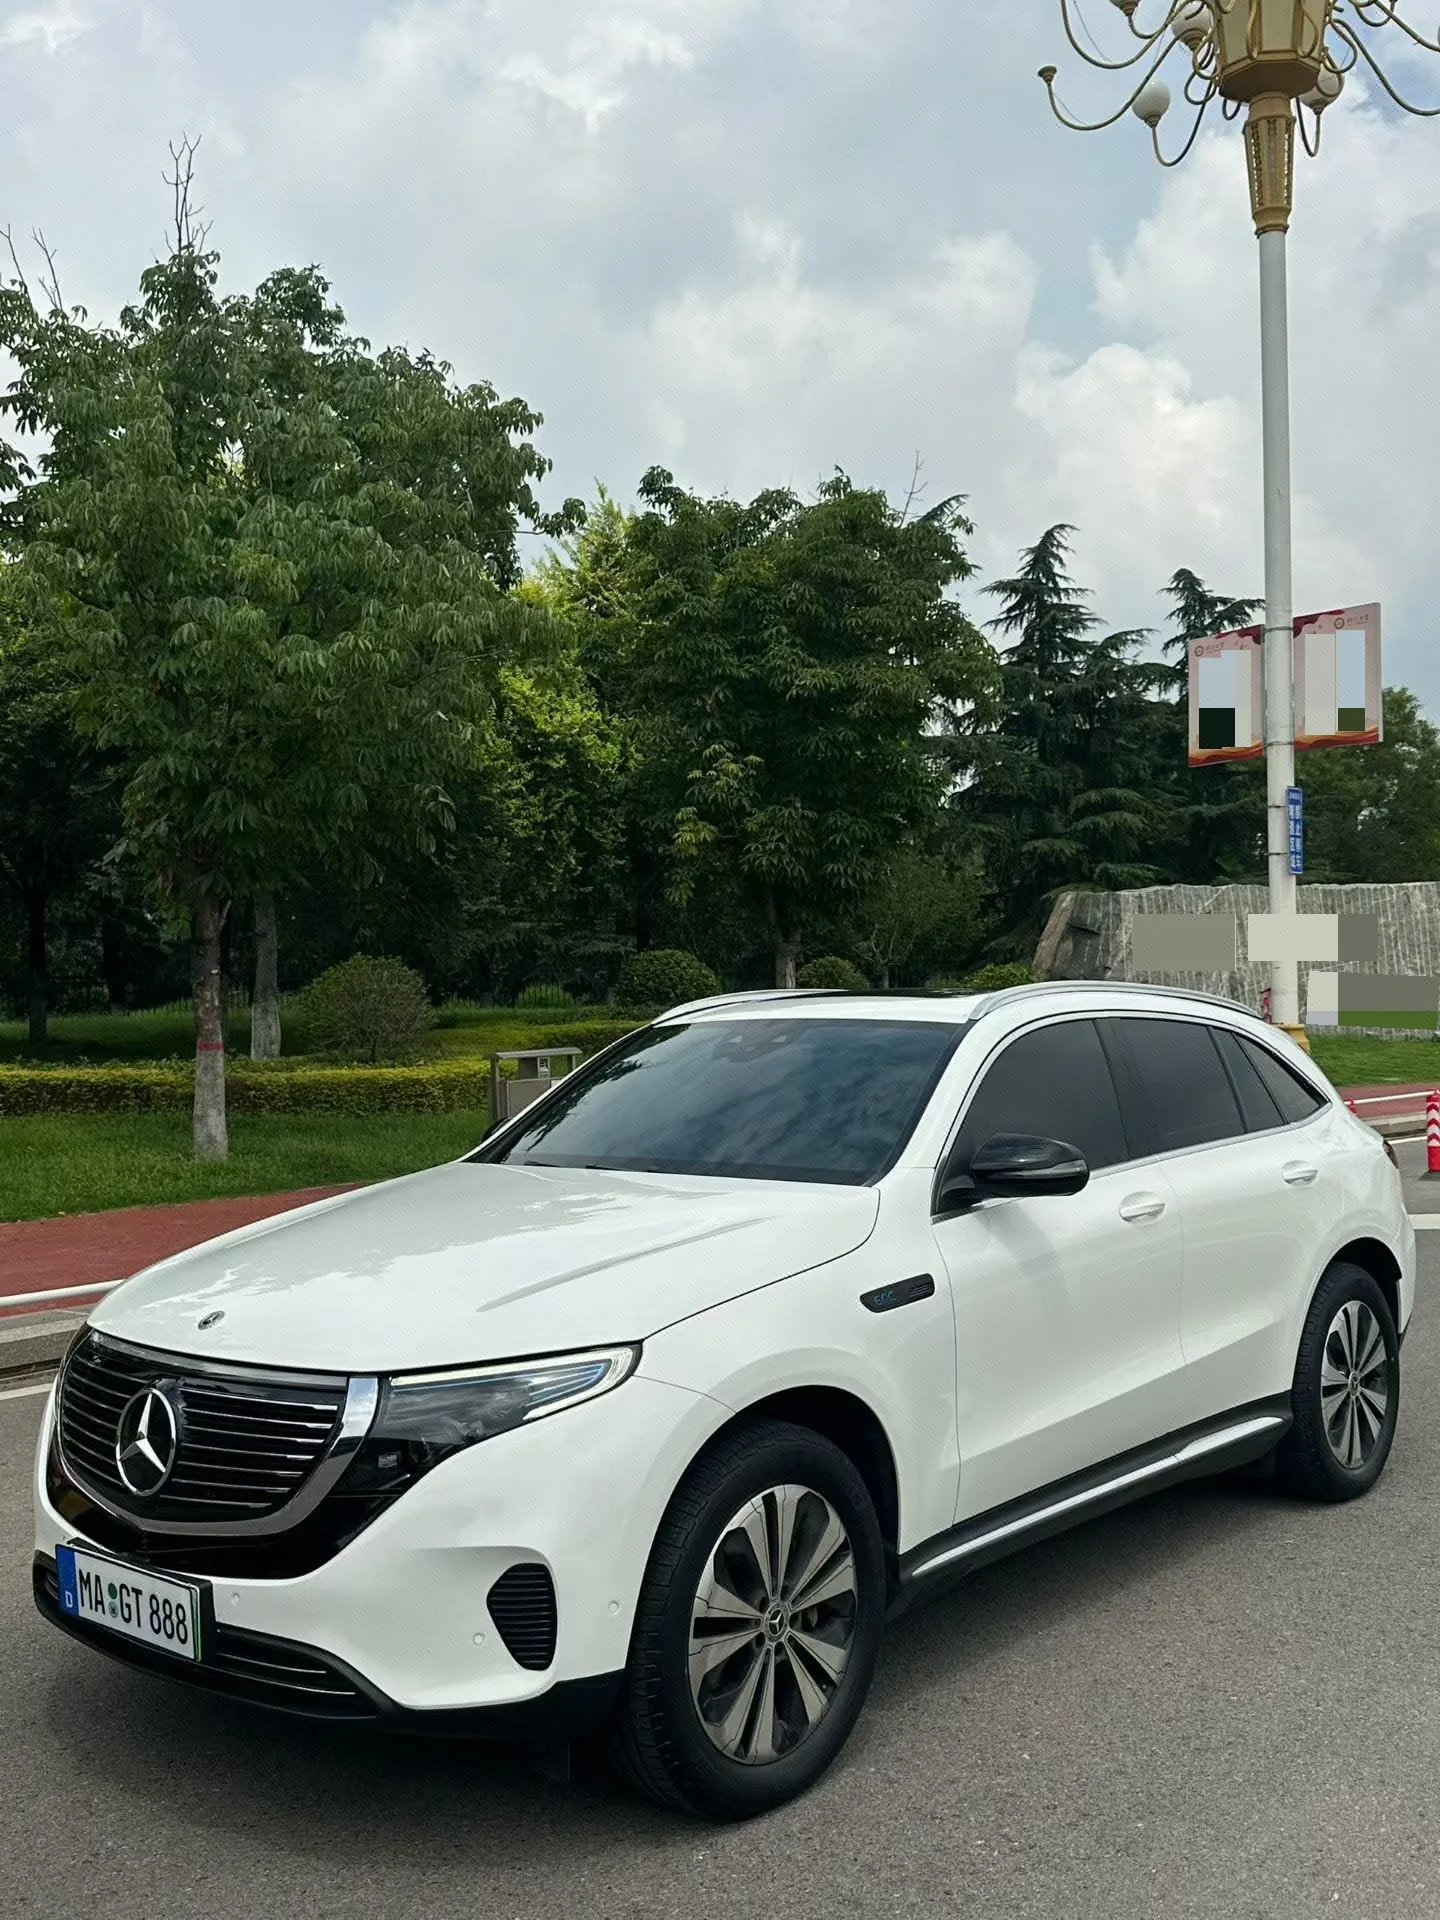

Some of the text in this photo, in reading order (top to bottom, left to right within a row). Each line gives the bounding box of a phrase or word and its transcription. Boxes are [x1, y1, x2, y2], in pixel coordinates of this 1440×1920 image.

[65, 1590, 73, 1608] D
[79, 1568, 188, 1645] MA GT 888
